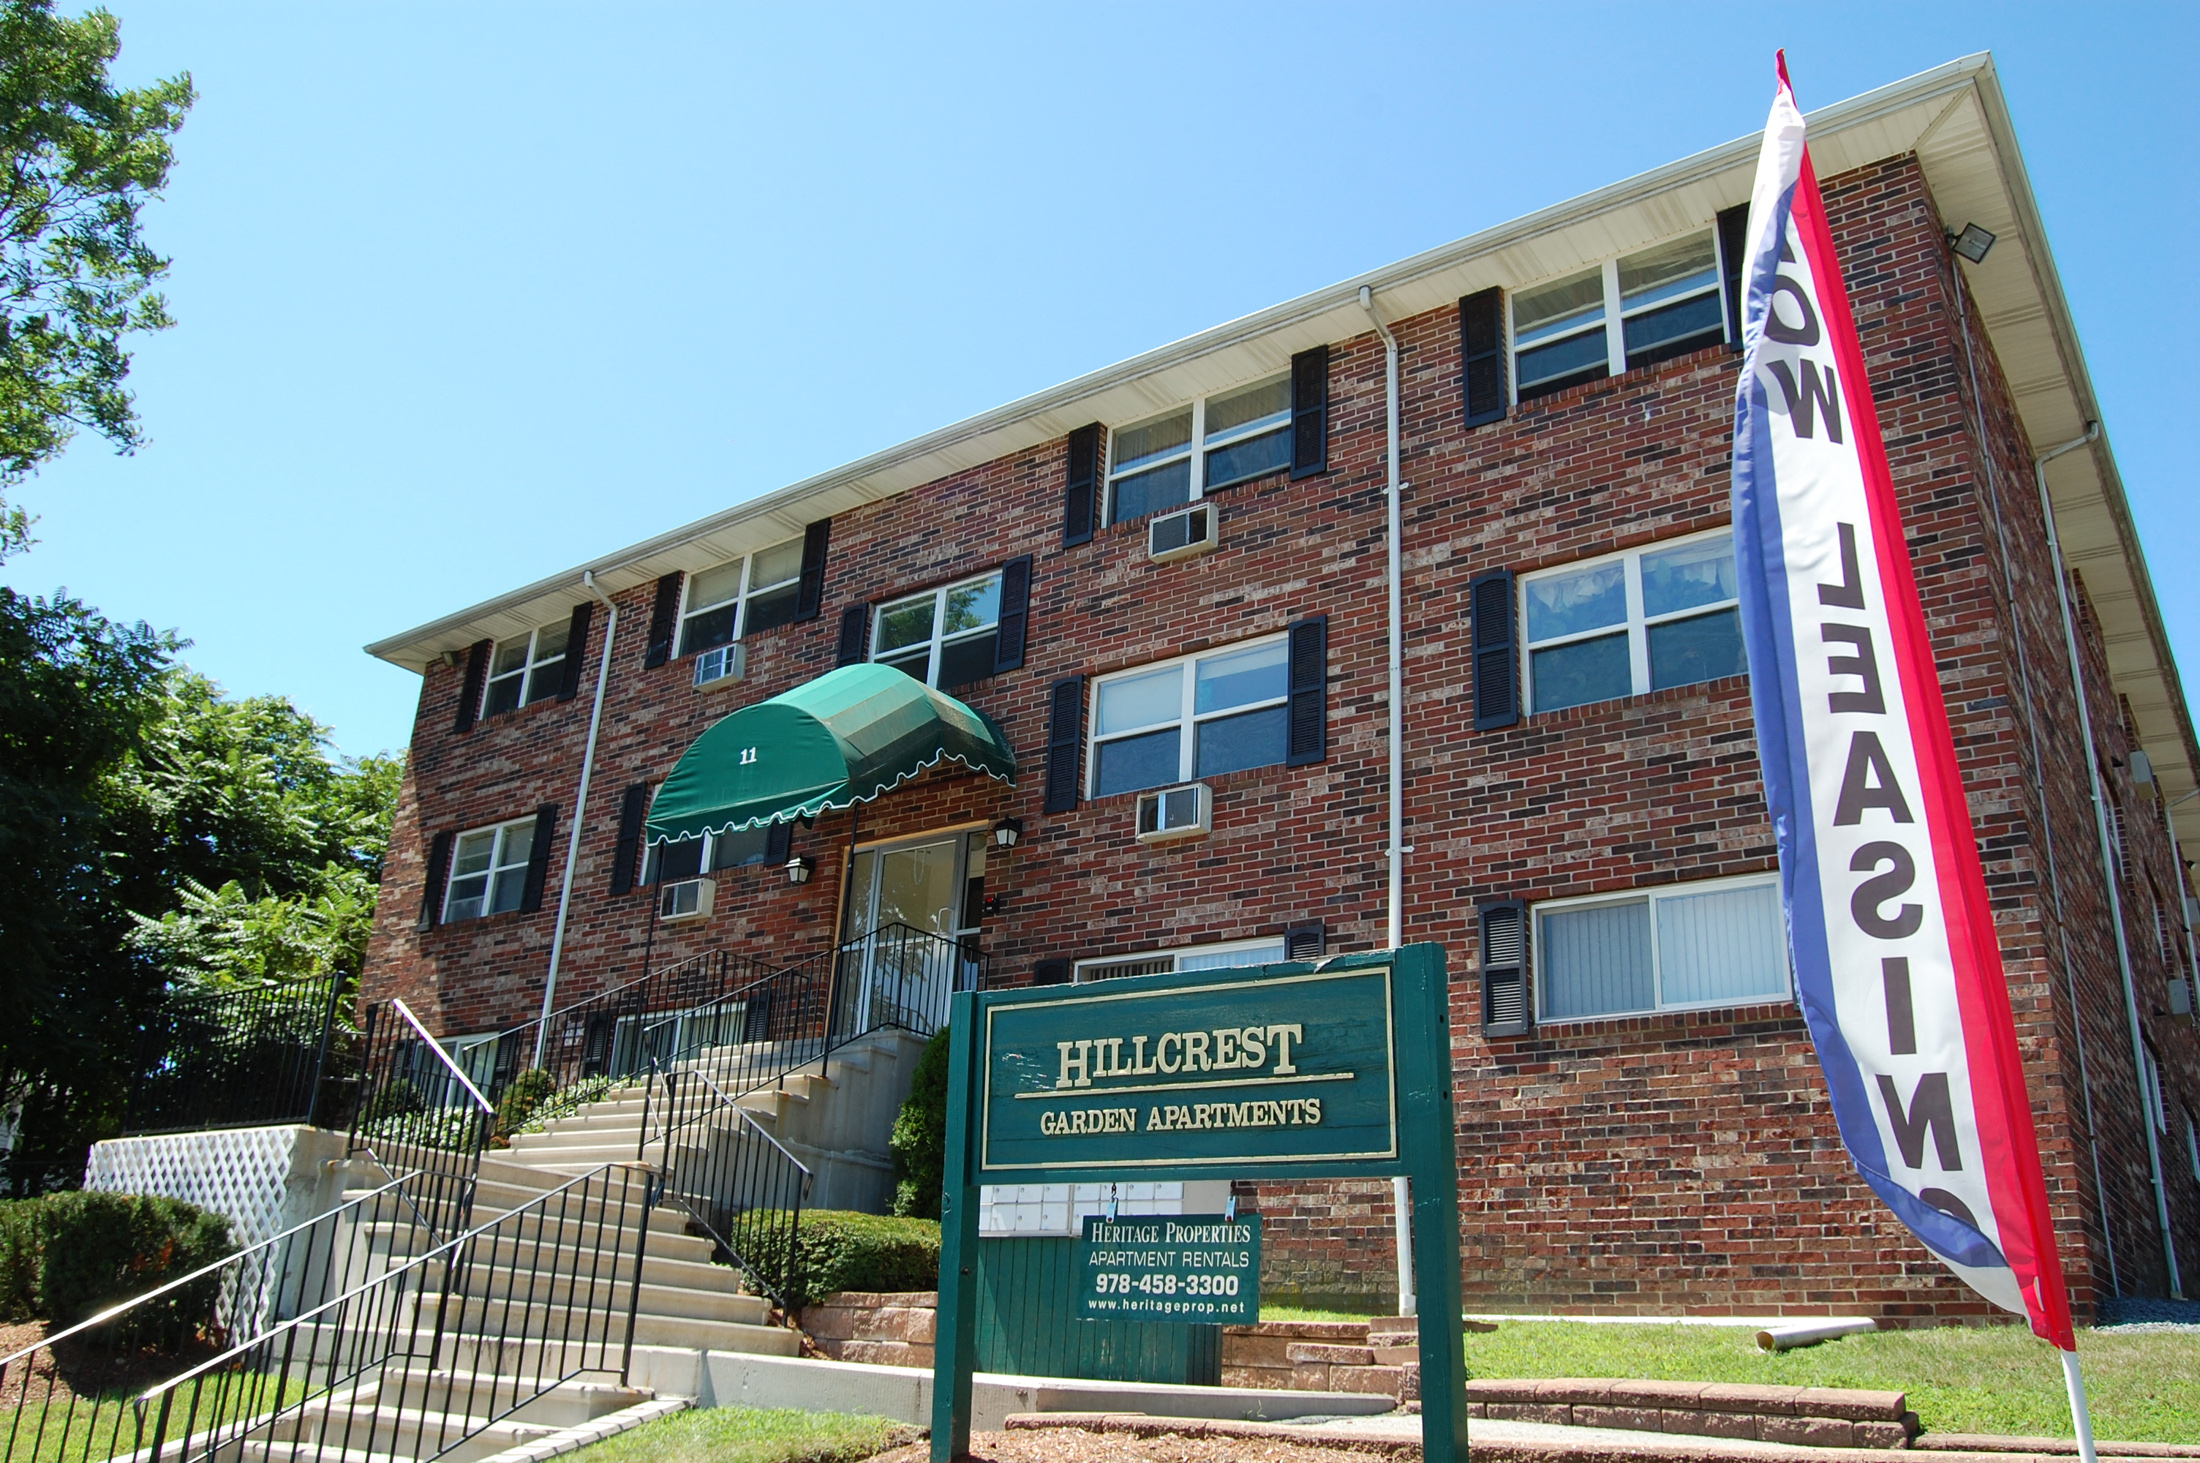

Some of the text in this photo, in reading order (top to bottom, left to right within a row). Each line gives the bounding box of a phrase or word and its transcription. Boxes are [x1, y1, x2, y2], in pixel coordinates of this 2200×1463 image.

[739, 746, 757, 765] 11
[1056, 1024, 1302, 1088] HILLCREST
[1040, 1098, 1321, 1135] GARDEN APARTMENTS
[1091, 1222, 1251, 1243] HERITAGE PROPERTIES
[1088, 1251, 1249, 1268] APARTMENT RENTALS
[1095, 1273, 1239, 1296] 978-458-3300
[1088, 1298, 1245, 1314] www.heritageprop.net
